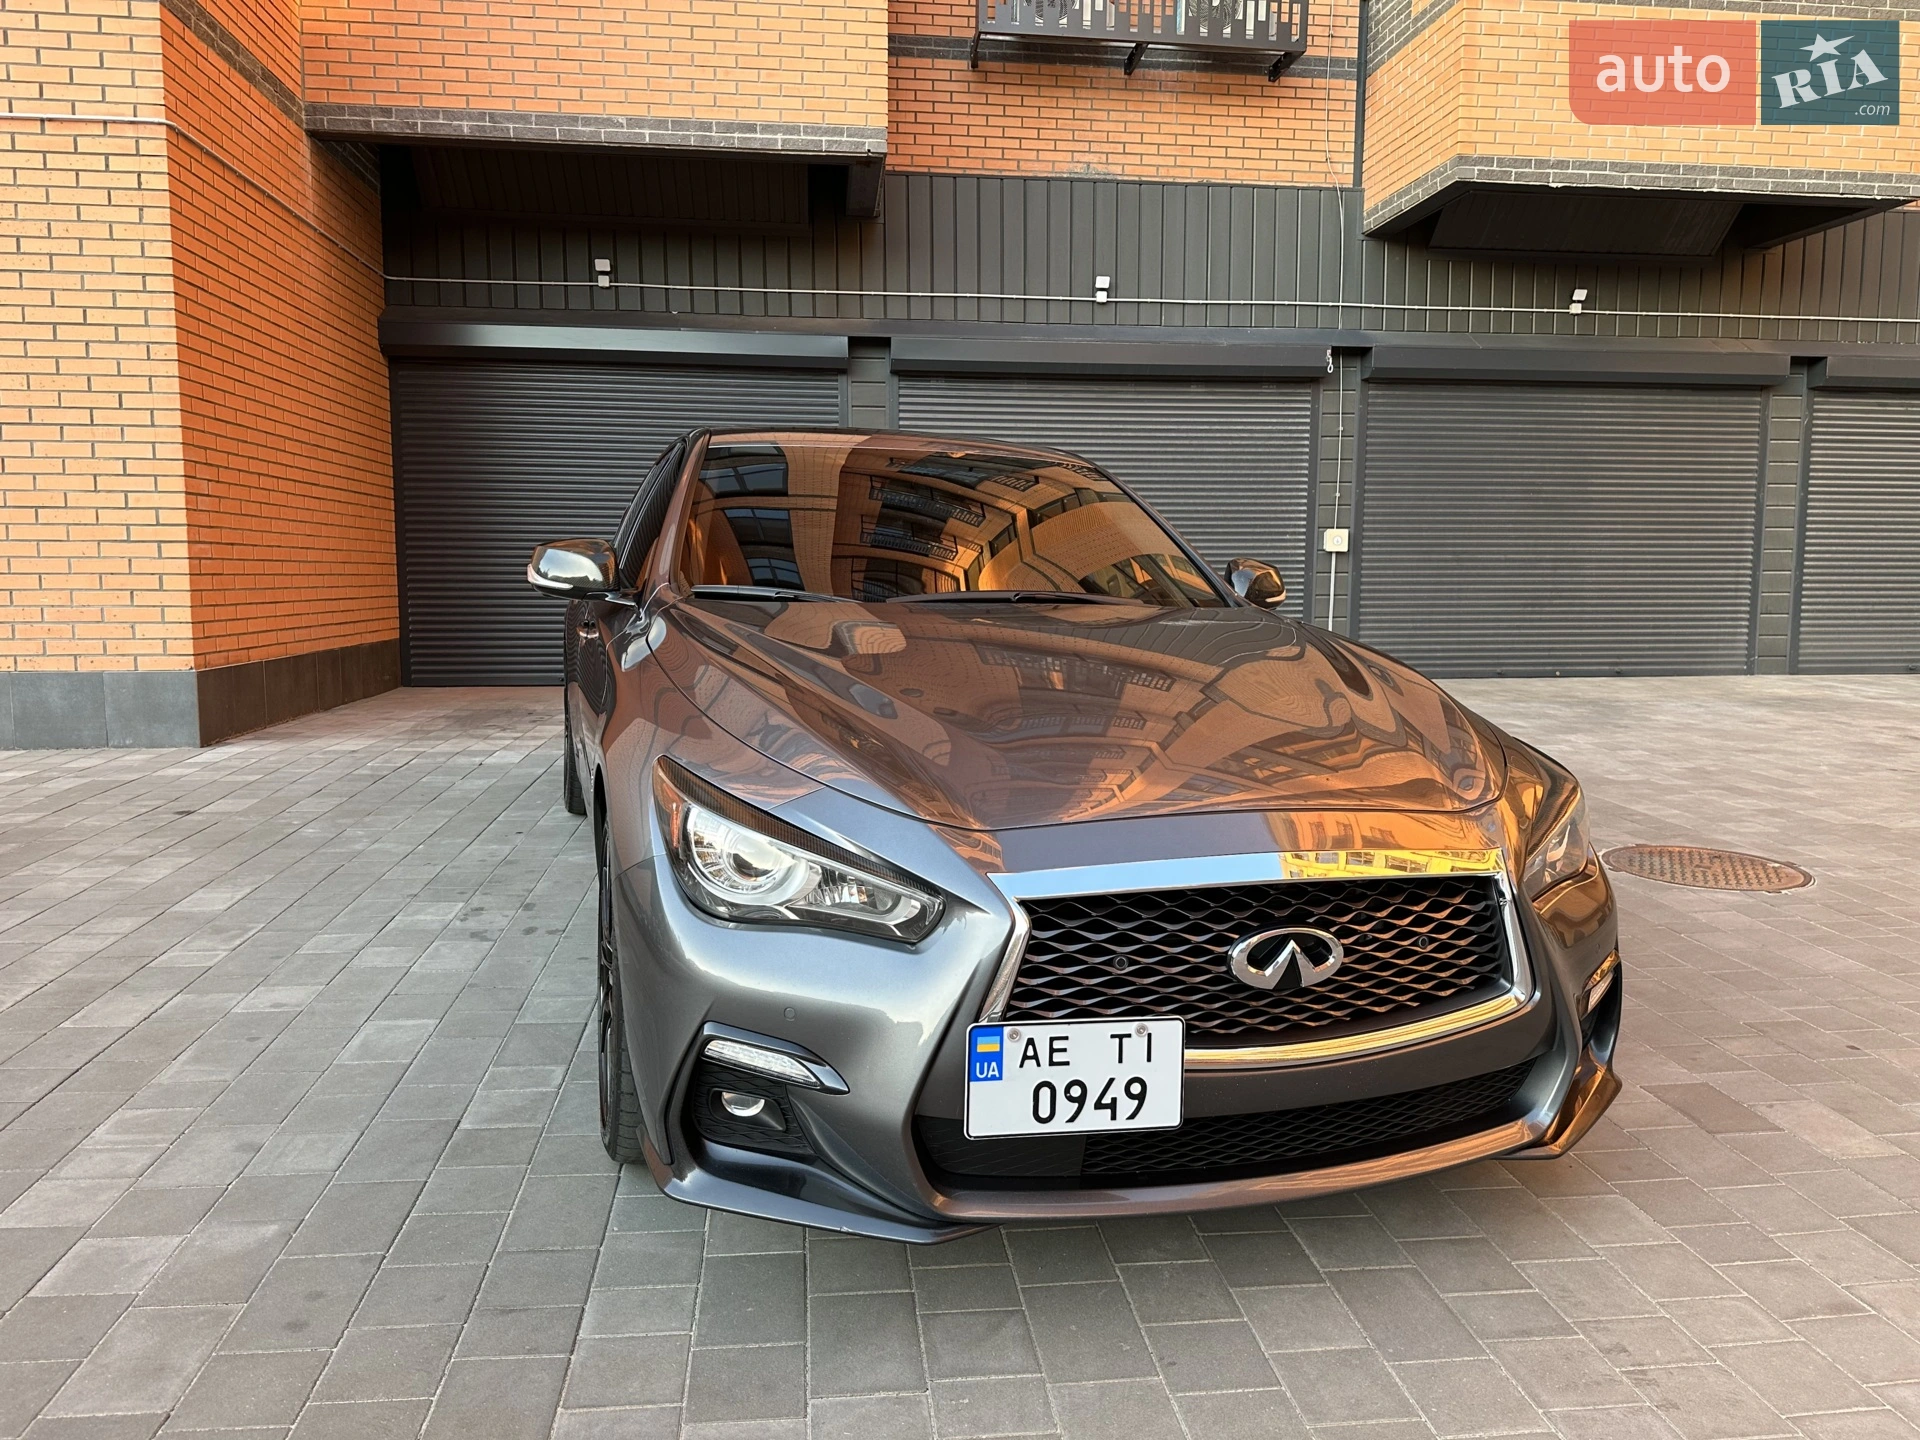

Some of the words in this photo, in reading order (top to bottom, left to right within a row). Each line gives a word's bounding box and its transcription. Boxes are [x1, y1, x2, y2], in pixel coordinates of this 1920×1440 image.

[1019, 1036, 1070, 1068] AE
[1110, 1033, 1152, 1064] TI
[976, 1061, 999, 1078] UA
[1032, 1076, 1148, 1124] 0949
